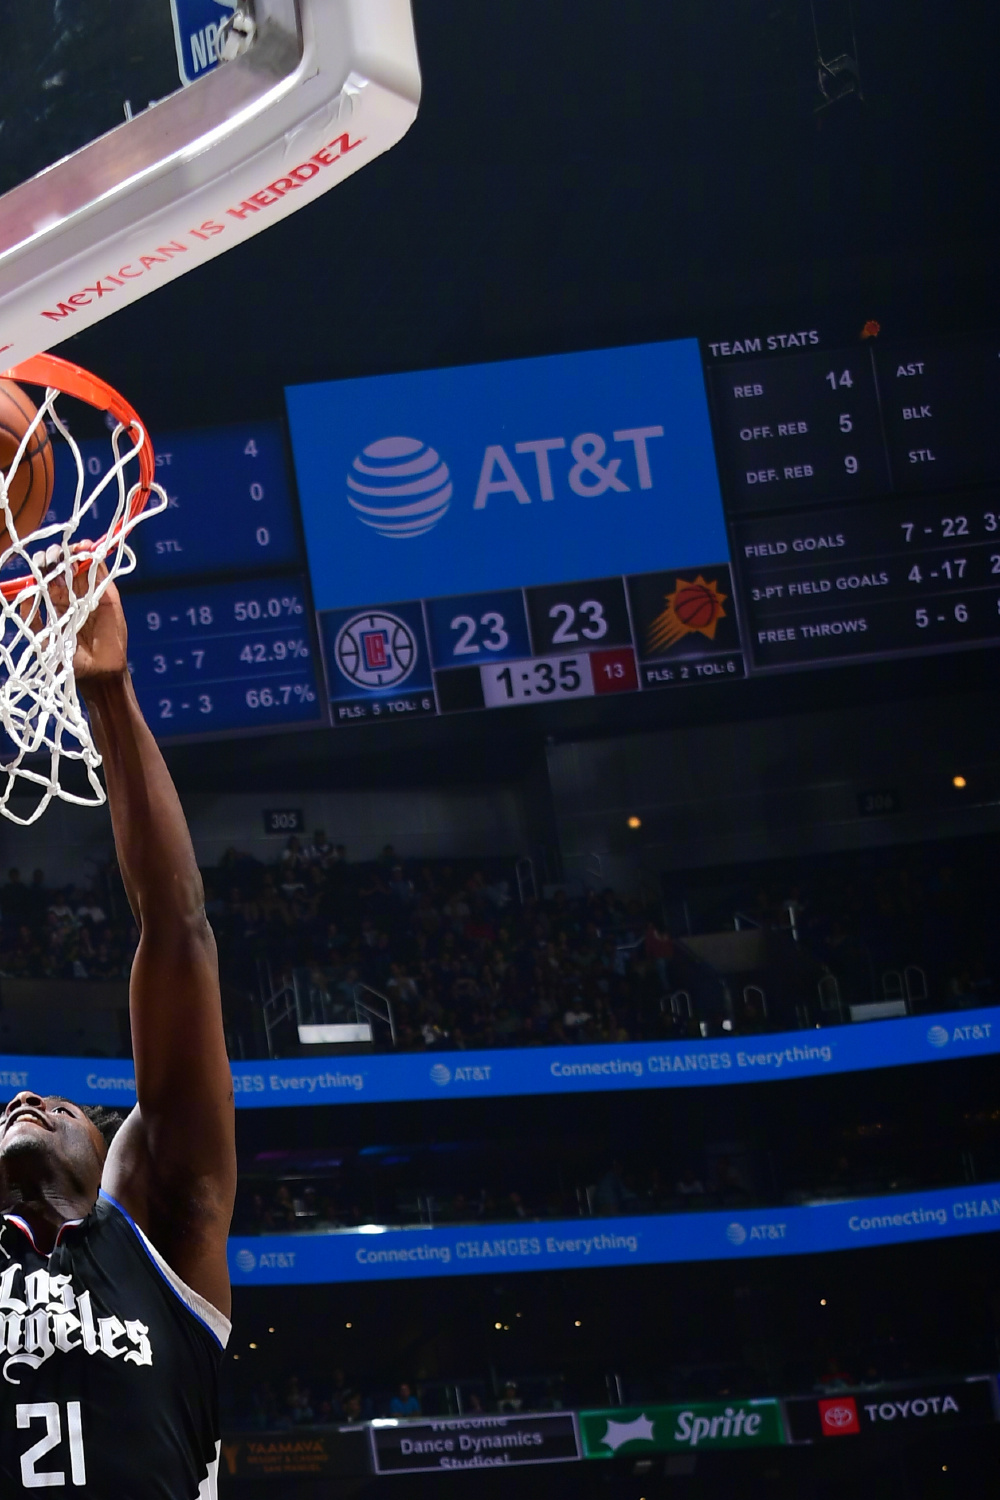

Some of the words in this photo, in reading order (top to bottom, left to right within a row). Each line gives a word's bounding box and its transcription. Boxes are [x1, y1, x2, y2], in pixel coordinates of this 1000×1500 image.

[197, 219, 224, 242] IS
[226, 132, 360, 222] HERDEZ
[709, 337, 762, 357] TEAM
[767, 331, 820, 351] STATS
[897, 363, 925, 377] AST
[734, 384, 764, 399] REB
[826, 370, 853, 391] 14
[903, 406, 932, 420] BLK
[740, 427, 774, 441] OFF.
[778, 422, 808, 437] REB
[839, 414, 853, 433] 5
[154, 453, 173, 467] ST
[244, 439, 258, 458] 4
[909, 450, 936, 464] STL
[473, 425, 664, 510] AT&T
[746, 470, 779, 485] DEF.
[784, 465, 814, 480] REB
[844, 456, 858, 475] 9
[250, 482, 263, 501] 0
[156, 540, 182, 554] STL
[256, 528, 270, 546] 0
[745, 542, 787, 558] FIELD
[793, 535, 845, 553] GOALS
[901, 524, 915, 543] 7
[941, 516, 970, 538] 22
[983, 512, 1000, 532] 3
[752, 586, 784, 601] 3-PT
[788, 579, 831, 596] FIELD
[836, 572, 889, 590] GOALS
[908, 565, 922, 584] 4
[147, 612, 160, 631] 9
[187, 606, 213, 626] 18
[234, 597, 303, 621] 50.0%
[549, 600, 608, 645] 23
[758, 629, 796, 644] FREE
[800, 619, 868, 639] THROWS
[915, 609, 929, 628] 5
[954, 604, 968, 622] 6
[450, 612, 509, 656] 23
[154, 655, 167, 673] 3
[193, 651, 205, 669] 7
[240, 640, 308, 664] 42.9%
[496, 660, 581, 700] 1:35
[604, 664, 624, 679] 13
[160, 699, 173, 718] 2
[200, 695, 213, 713] 3
[246, 684, 315, 709] 66.7%
[952, 1024, 991, 1041] AT&T
[454, 1066, 491, 1082] AT&T
[551, 1058, 643, 1077] Connecting
[648, 1053, 731, 1073] CHANGES
[737, 1044, 831, 1068] Everything
[270, 1071, 363, 1093] Everything
[749, 1224, 786, 1241] AT&T
[848, 1206, 947, 1232] Connecting
[259, 1252, 295, 1268] AT&T
[356, 1246, 451, 1266] Connecting
[456, 1239, 540, 1260] CHANGES
[546, 1234, 637, 1256] Everything
[864, 1395, 960, 1423] TOYOTA
[674, 1406, 761, 1445] Sprite
[16, 1401, 86, 1488] 21
[400, 1438, 454, 1456] Dance
[459, 1431, 543, 1454] Dynamics
